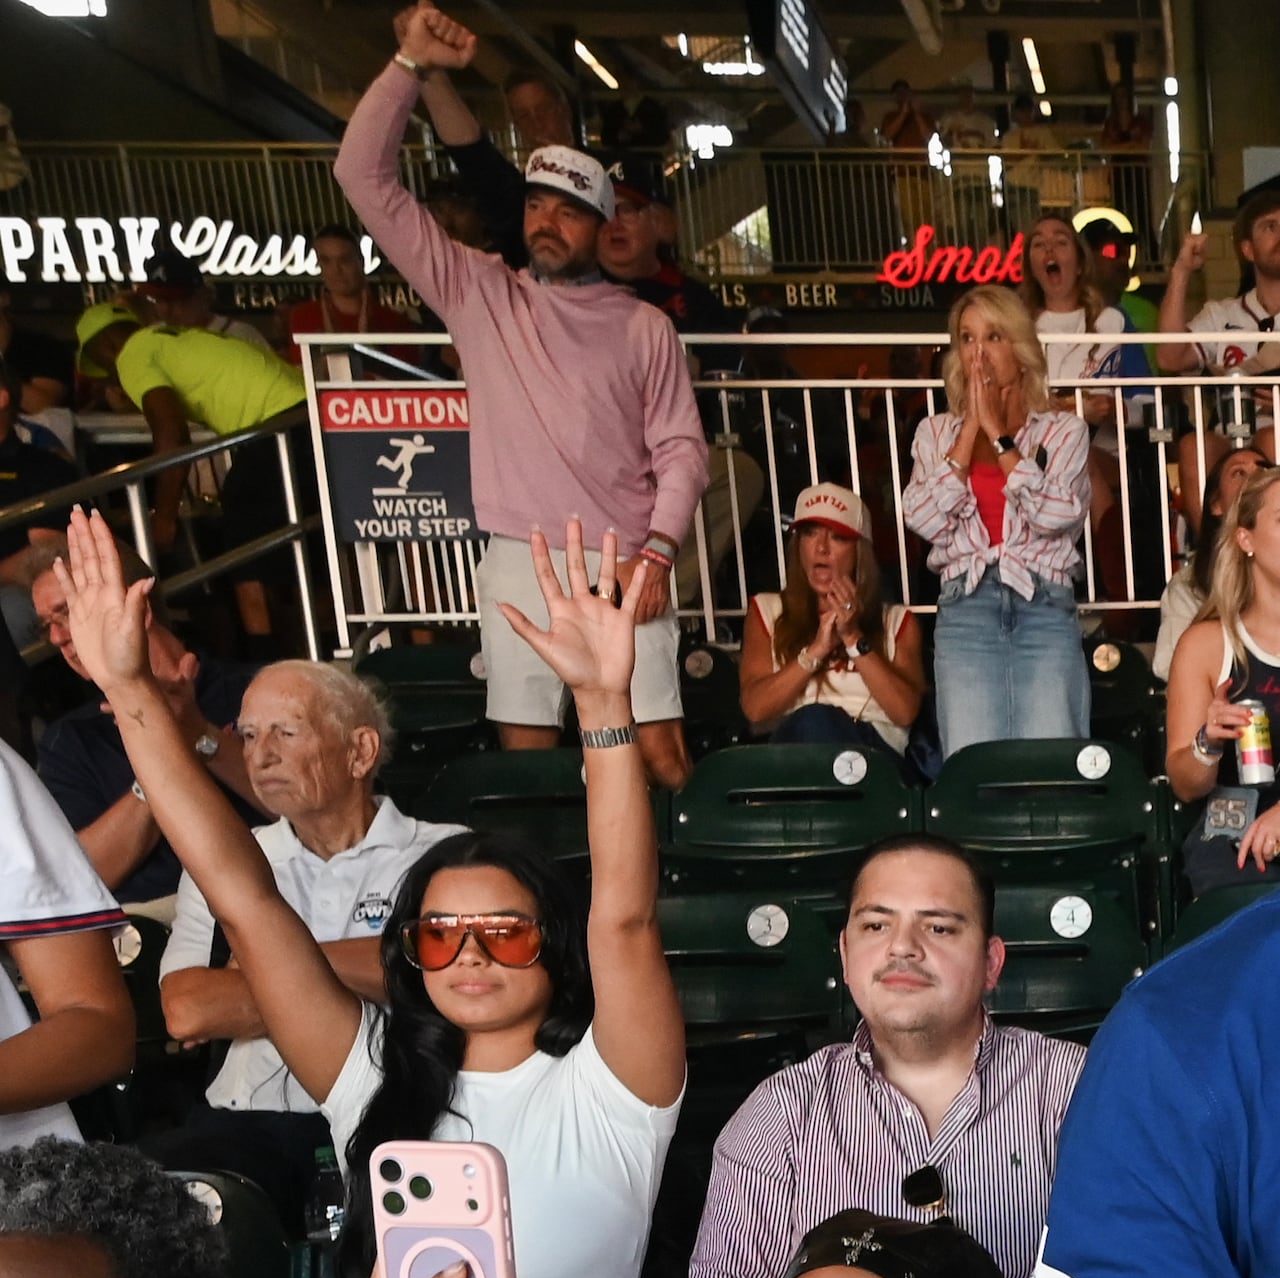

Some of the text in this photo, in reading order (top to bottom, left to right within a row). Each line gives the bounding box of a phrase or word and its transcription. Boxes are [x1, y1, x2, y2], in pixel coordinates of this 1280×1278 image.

[0, 216, 160, 283] PARK
[233, 283, 324, 308] PEANUT
[785, 283, 837, 307] BEER
[880, 284, 935, 307] SODA
[327, 397, 469, 425] CAUTION
[372, 498, 448, 517] WATCH
[354, 518, 470, 537] YOUR STEP
[763, 917, 773, 934] 3
[1066, 909, 1077, 925] 4
